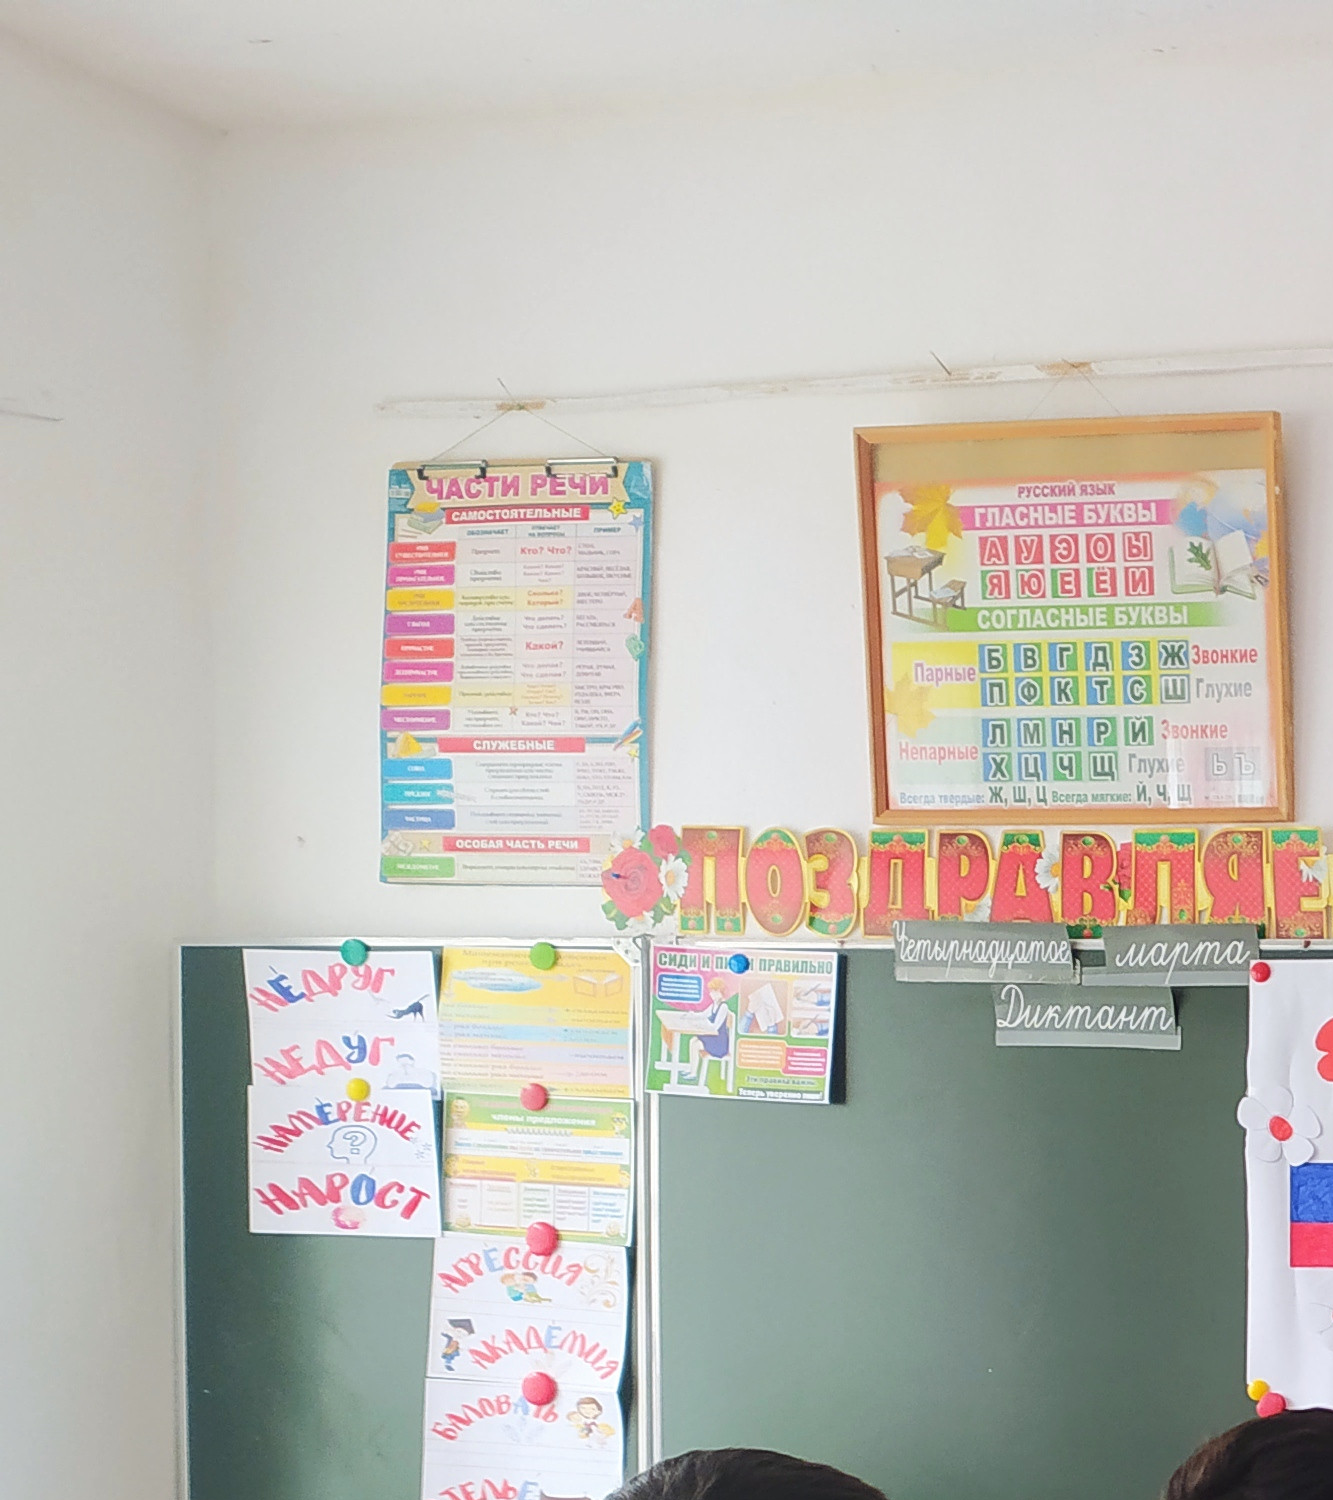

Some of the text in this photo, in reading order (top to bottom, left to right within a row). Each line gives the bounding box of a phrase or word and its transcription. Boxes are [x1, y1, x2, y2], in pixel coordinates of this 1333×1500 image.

[426, 473, 610, 500] ЧАСТИ РЕЧИ
[1017, 481, 1116, 499] РУССКИЙ ЯЗЫК
[452, 508, 581, 521] САМОСТОЯТЕЛЬНЫЕ
[974, 500, 1157, 527] ГЛАСНЫЕ БУКВЫ
[520, 547, 544, 555] Кто?
[547, 546, 572, 555] Что?
[977, 604, 1188, 629] СОГЛАСНЫЕ БУКВЫ
[526, 641, 563, 650] Какой?
[1191, 644, 1259, 665] Звонкие
[914, 663, 976, 687] Парные
[1195, 677, 1253, 704] Глухие
[1160, 718, 1229, 741] Звонкие
[474, 740, 554, 750] СЛУЖЕБНЫЕ
[898, 739, 979, 766] Непарные
[1128, 755, 1184, 776] Глухие
[899, 791, 936, 806] Всегда
[988, 786, 1008, 807] Ж,
[1012, 785, 1032, 807] Ш,
[1035, 785, 1048, 807] Ц
[1051, 790, 1089, 805] Всегда
[1090, 792, 1132, 804] мягкие:
[1136, 780, 1152, 806] Й,
[456, 839, 578, 849] ОСОБАЯ ЧАСТЬ РЕЧИ
[659, 953, 697, 968] СИДИ
[702, 957, 710, 968] И
[759, 959, 832, 974] ПРАВИЛЬНО
[893, 920, 1250, 984] Четырнадцатое марта
[996, 984, 1175, 1031] Диктант
